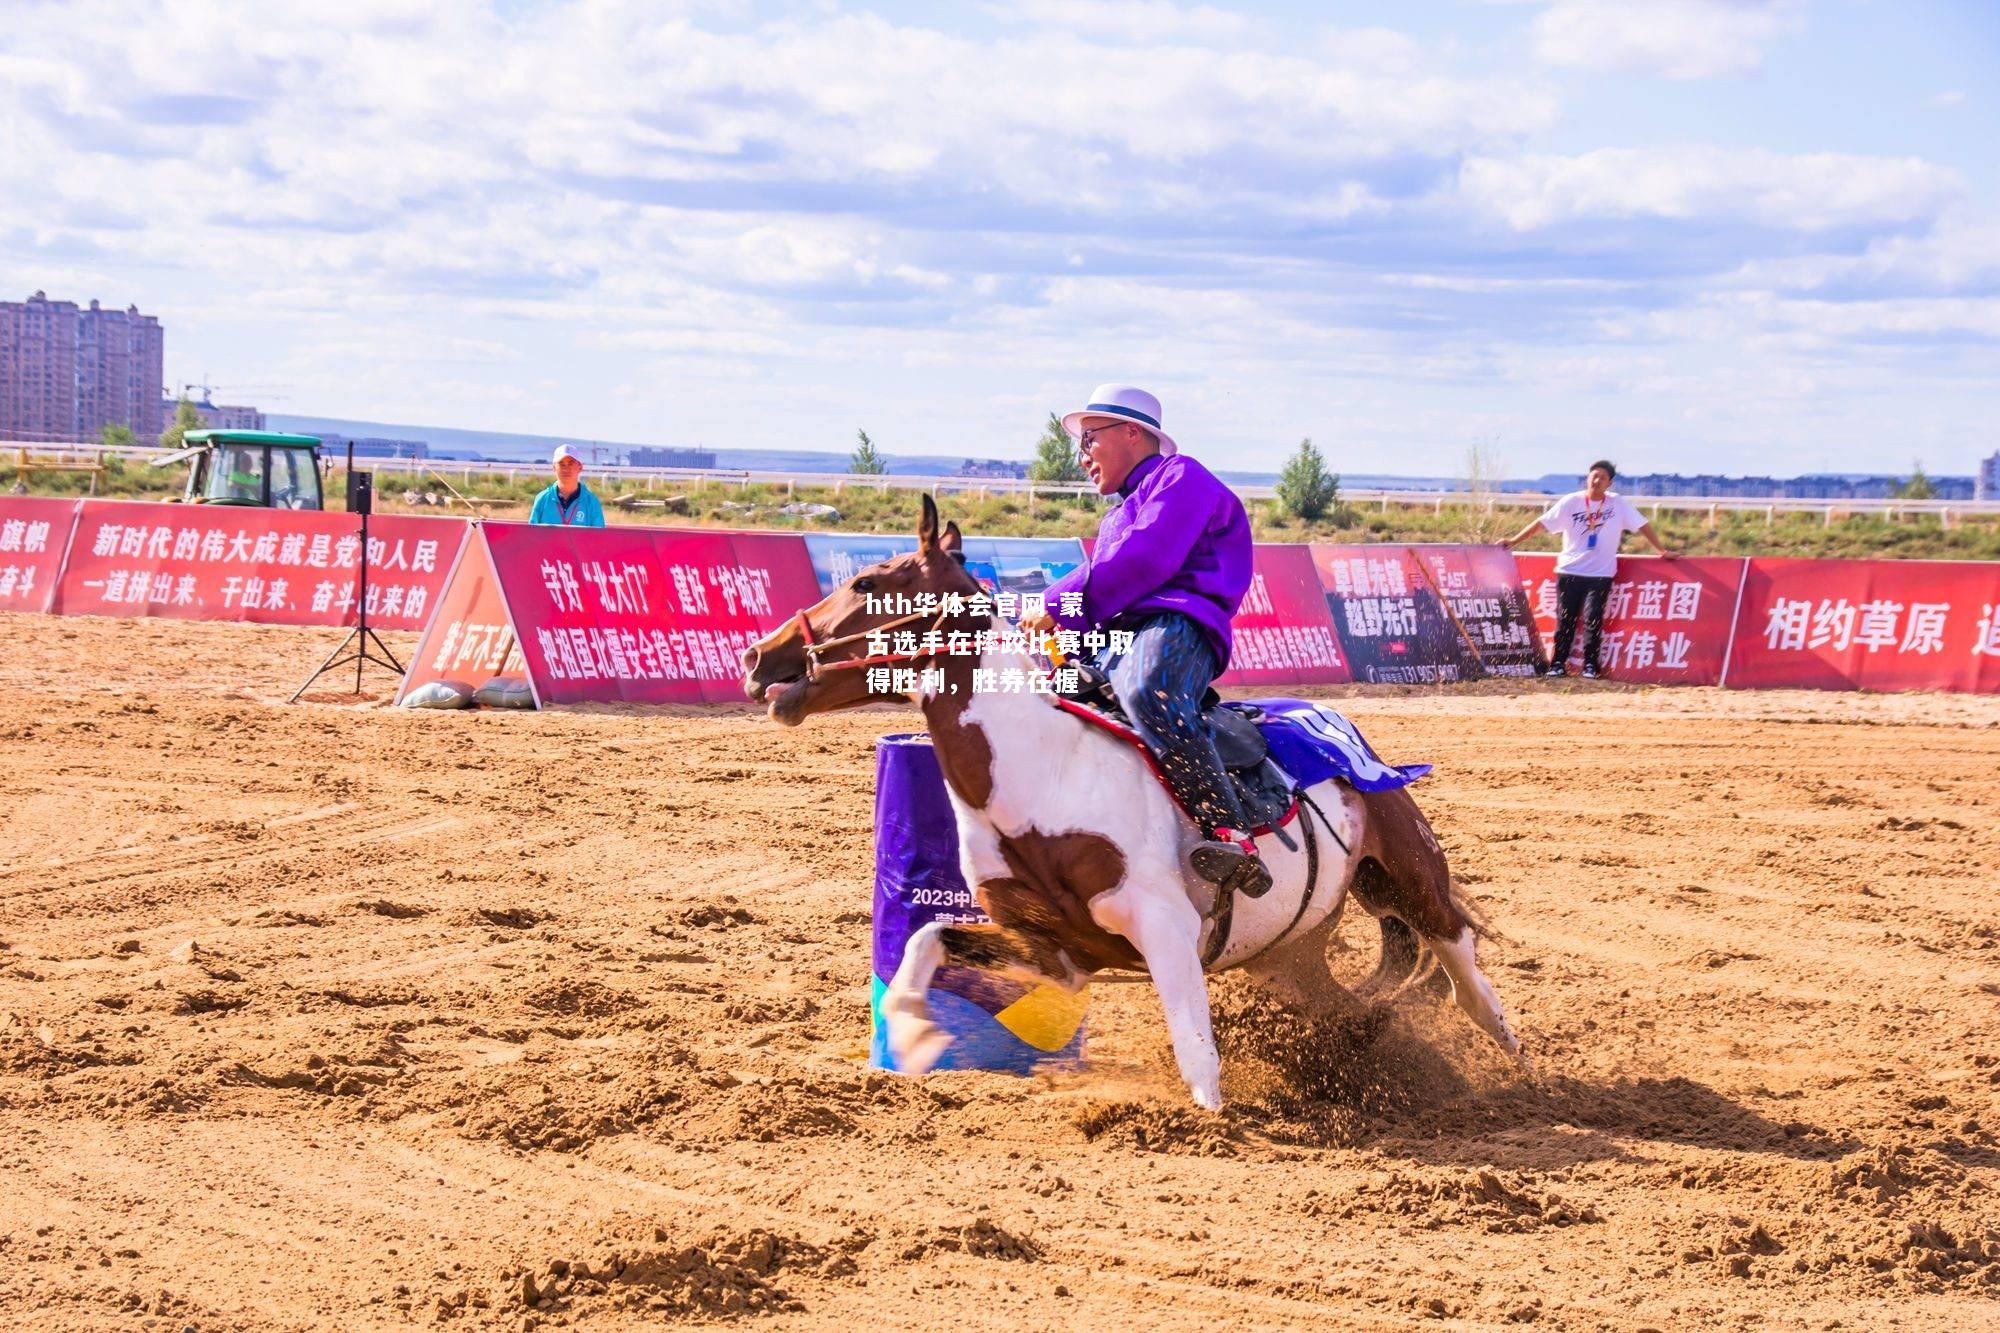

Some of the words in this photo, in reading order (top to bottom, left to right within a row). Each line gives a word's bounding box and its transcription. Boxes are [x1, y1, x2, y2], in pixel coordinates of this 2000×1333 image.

[92, 523, 439, 573] 新时代的伟大成就是党和人民
[83, 570, 428, 618] 一道拼出来、干出来、奋斗出来的
[1437, 568, 1468, 588] FAST
[1344, 598, 1417, 637] 越野先行
[1763, 597, 1951, 655] 相约草原
[536, 627, 771, 680] 把祖国北疆安全稳定屏障构筑
